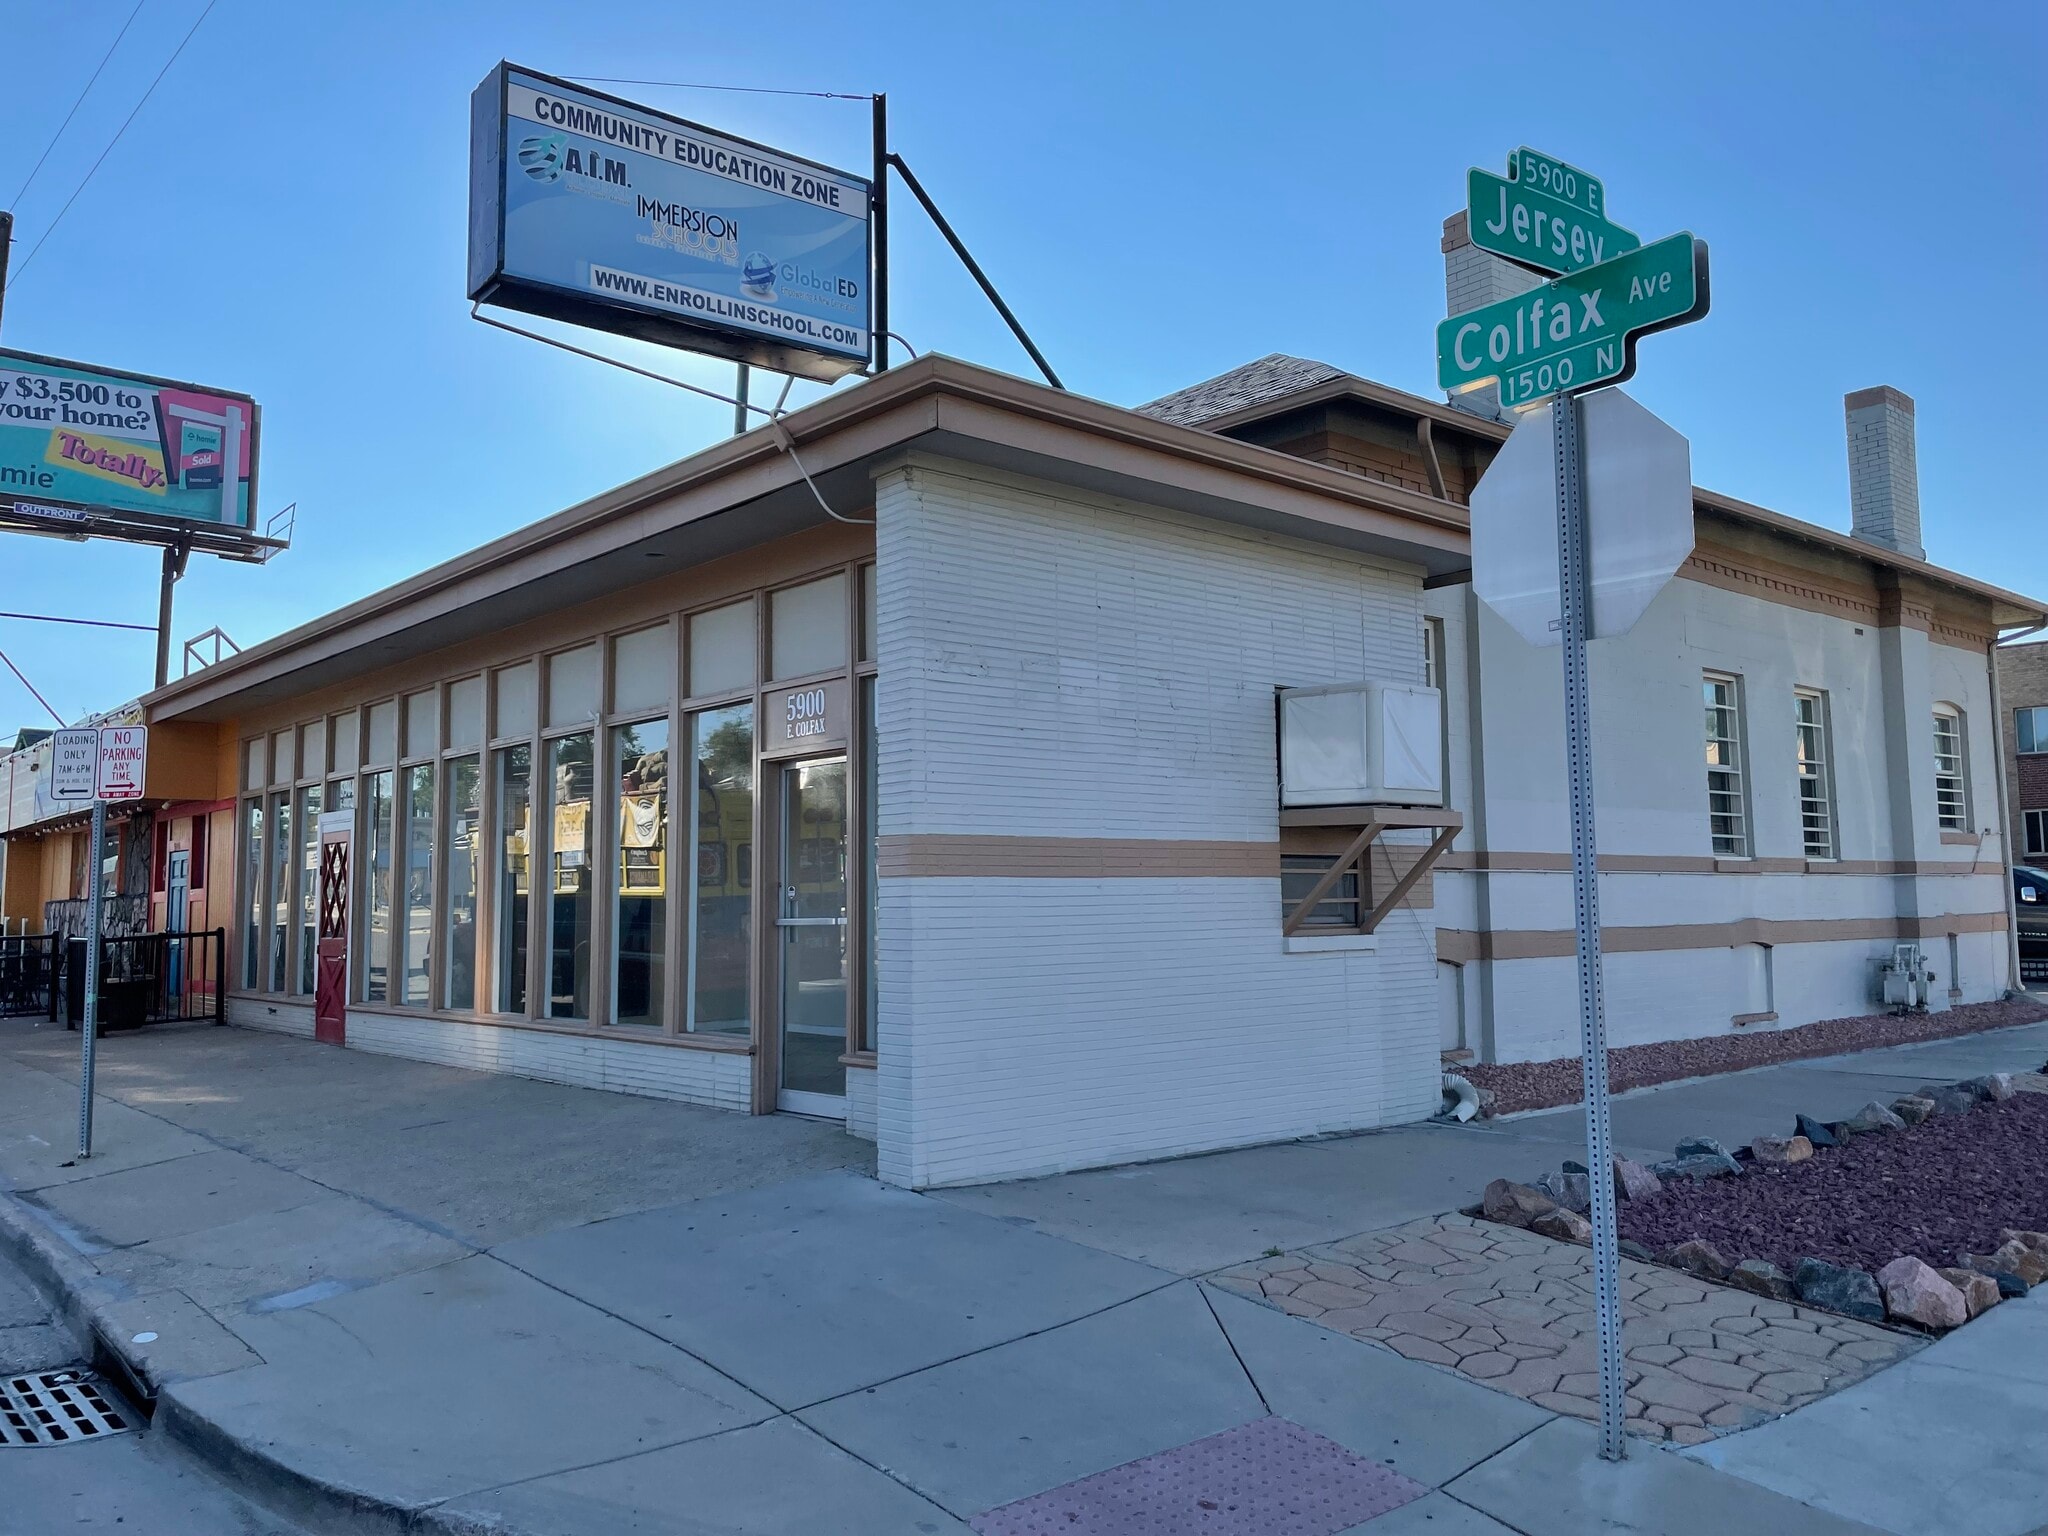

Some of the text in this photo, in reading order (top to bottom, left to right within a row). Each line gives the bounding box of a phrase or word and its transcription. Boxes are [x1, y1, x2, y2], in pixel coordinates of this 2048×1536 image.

[534, 96, 667, 155] COMMUNITY
[674, 138, 786, 191] EDUCATION
[790, 173, 840, 208] ZONE
[565, 148, 632, 188] A.I.M.
[1525, 156, 1599, 210] 5900 E
[637, 194, 738, 242] IMMERSION
[1485, 186, 1603, 265] Jersey
[653, 220, 739, 259] SCHOOLS
[781, 264, 858, 298] GlobalED
[594, 269, 859, 347] WWW.ENROLLINSCHOOL.COM
[1454, 271, 1672, 372] Colfax Ave
[1508, 343, 1614, 402] 1500 N
[15, 376, 110, 406] $3,500
[115, 390, 142, 409] to
[61, 403, 151, 431] home?
[192, 454, 212, 466] Sold
[20, 504, 80, 520] OUTFRONT
[786, 689, 825, 721] 5900
[57, 735, 95, 746] LOADING
[114, 731, 131, 745] NO
[795, 718, 825, 737] COLFAX
[59, 764, 91, 774] 7AM-6PM
[64, 750, 87, 760] ONLY
[102, 747, 142, 761] PARKING
[112, 762, 130, 771] ANY
[112, 771, 131, 781] TIME
